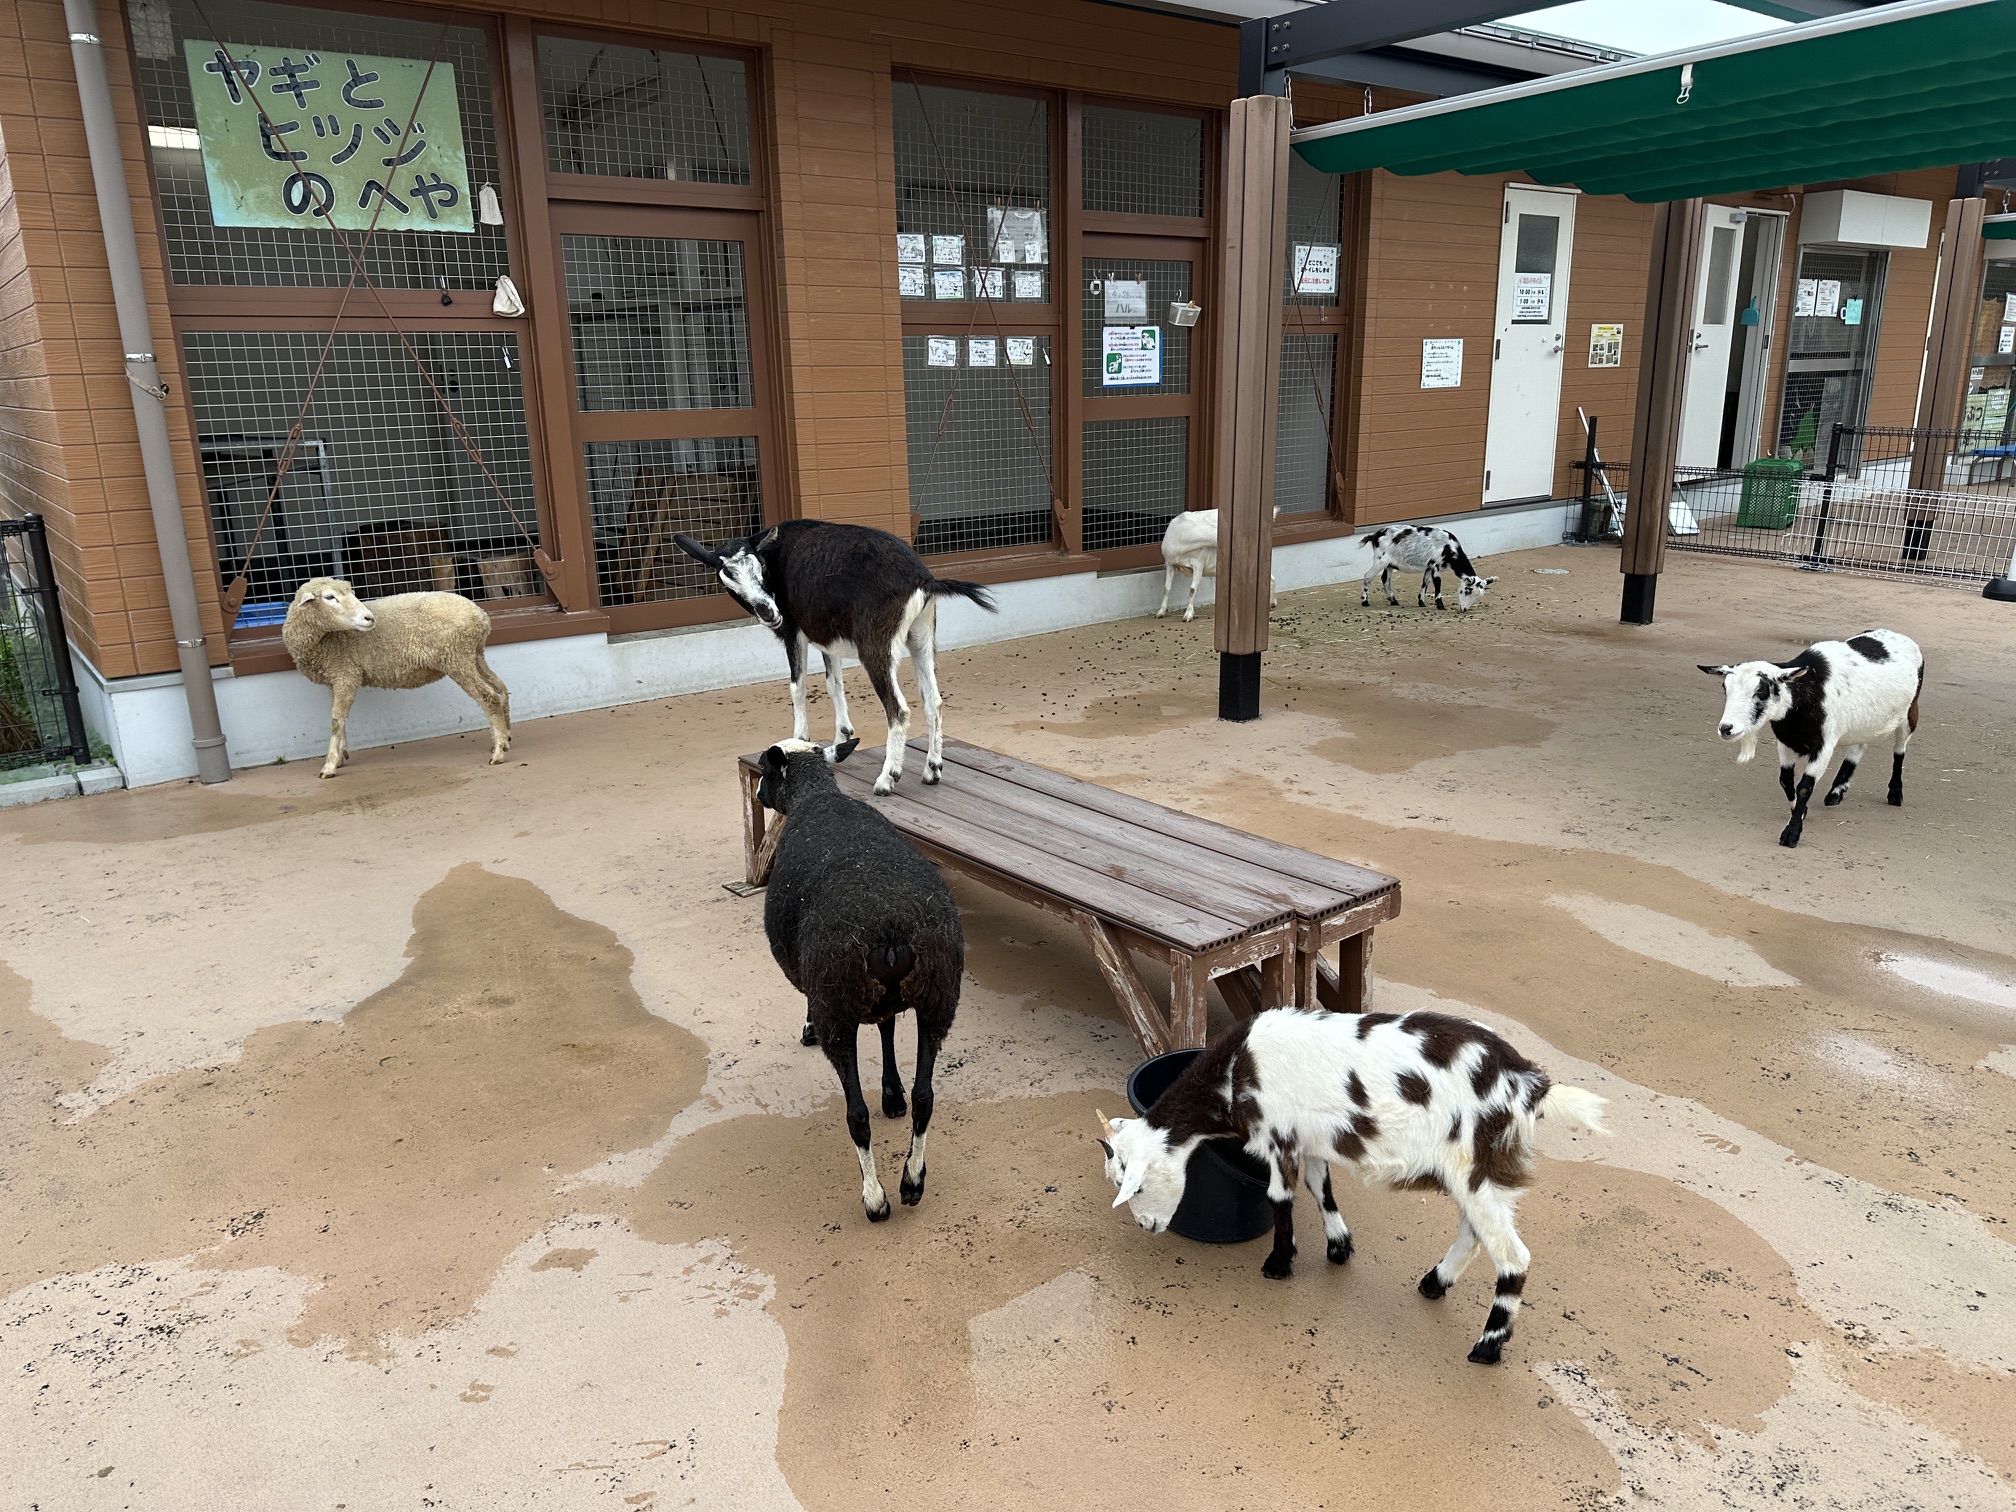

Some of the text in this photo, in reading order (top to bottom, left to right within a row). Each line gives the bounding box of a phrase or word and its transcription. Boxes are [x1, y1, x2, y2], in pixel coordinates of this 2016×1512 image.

[203, 48, 386, 110] ヤギと
[256, 111, 427, 167] ヒツジ
